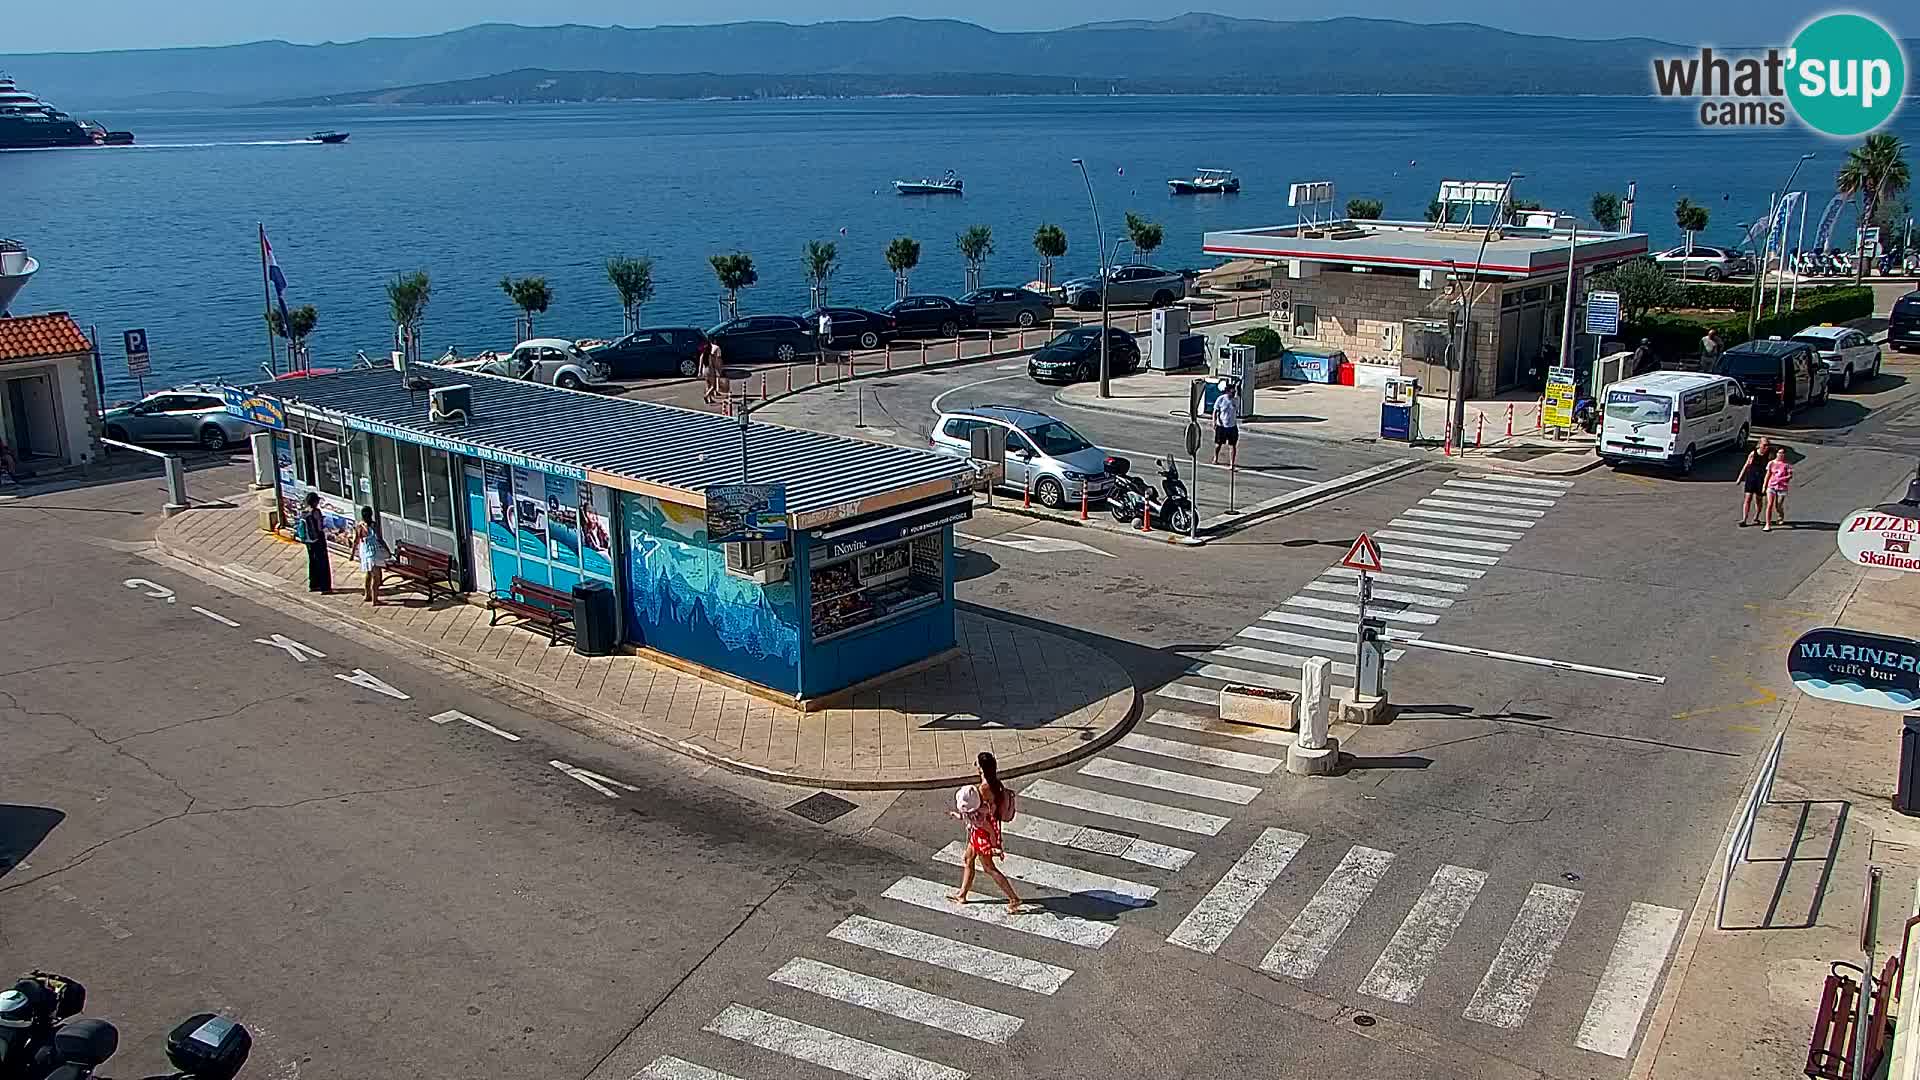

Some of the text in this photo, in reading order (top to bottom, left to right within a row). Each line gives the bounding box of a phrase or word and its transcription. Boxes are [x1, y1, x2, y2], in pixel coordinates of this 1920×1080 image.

[129, 332, 141, 351] P
[1612, 393, 1630, 402] TAXI
[435, 437, 467, 453] POSTAJA
[478, 447, 492, 459] BUS
[492, 450, 526, 467] STATION
[528, 459, 553, 473] TICKET
[554, 464, 582, 479] OFFICE
[1881, 531, 1917, 541] GRILL
[1828, 663, 1897, 681] caffe bar
